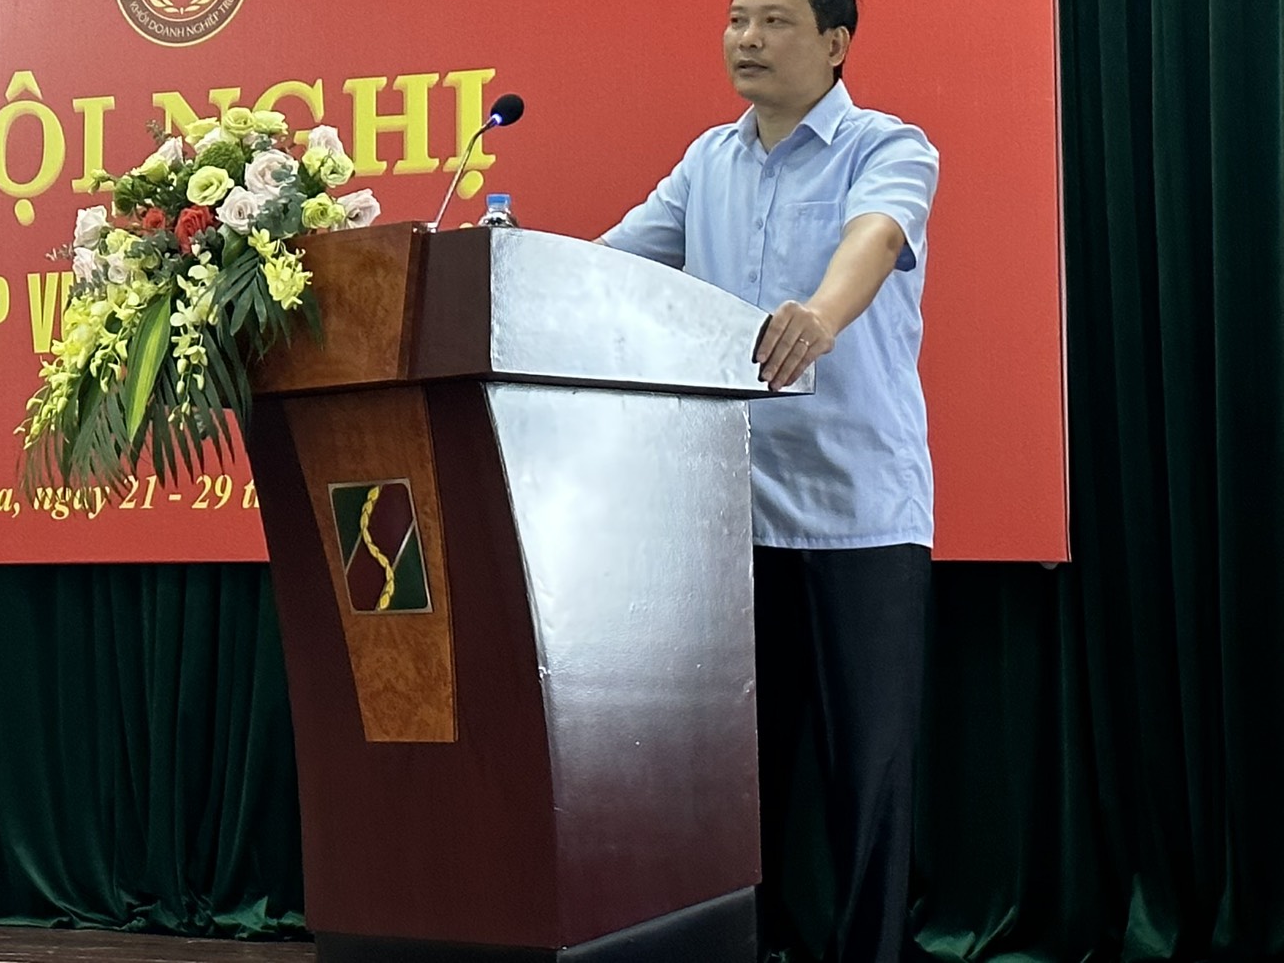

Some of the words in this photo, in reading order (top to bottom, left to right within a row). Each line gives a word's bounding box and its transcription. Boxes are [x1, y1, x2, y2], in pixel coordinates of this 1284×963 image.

[147, 20, 185, 38] DOANH
[118, 475, 157, 509] 21
[191, 474, 233, 510] 29
[242, 478, 260, 509] t
